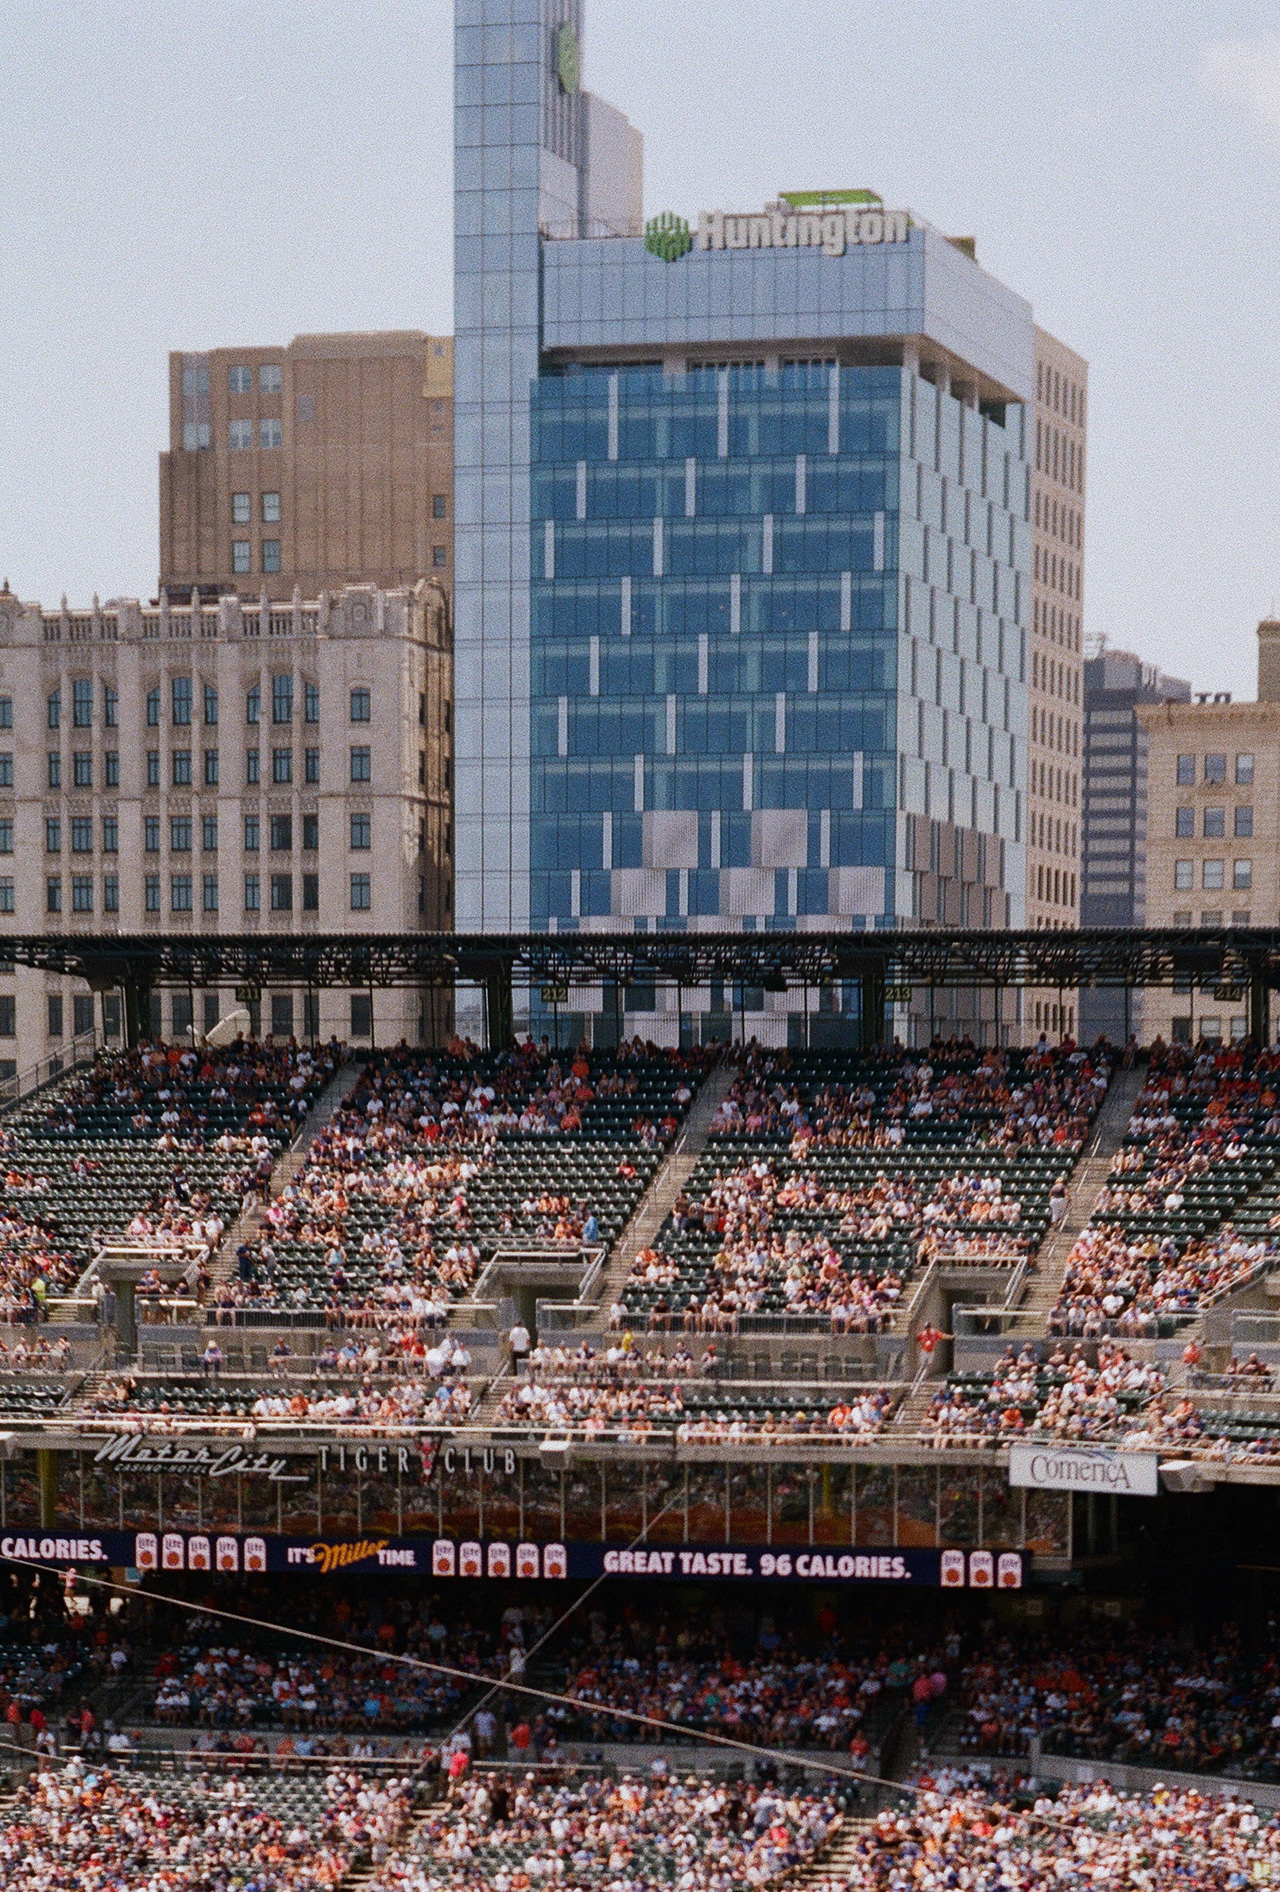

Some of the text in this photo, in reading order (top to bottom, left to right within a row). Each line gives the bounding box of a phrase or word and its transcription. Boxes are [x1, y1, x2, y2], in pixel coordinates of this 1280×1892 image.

[698, 208, 910, 257] Huntington
[885, 986, 910, 999] 213
[81, 1433, 310, 1482] Motor City
[318, 1445, 516, 1476] TIGER CLUB
[0, 1537, 109, 1562] CALORIES.
[314, 1540, 389, 1573] Miller
[603, 1550, 912, 1580] GREAT TASTE. 96 CALORIES.
